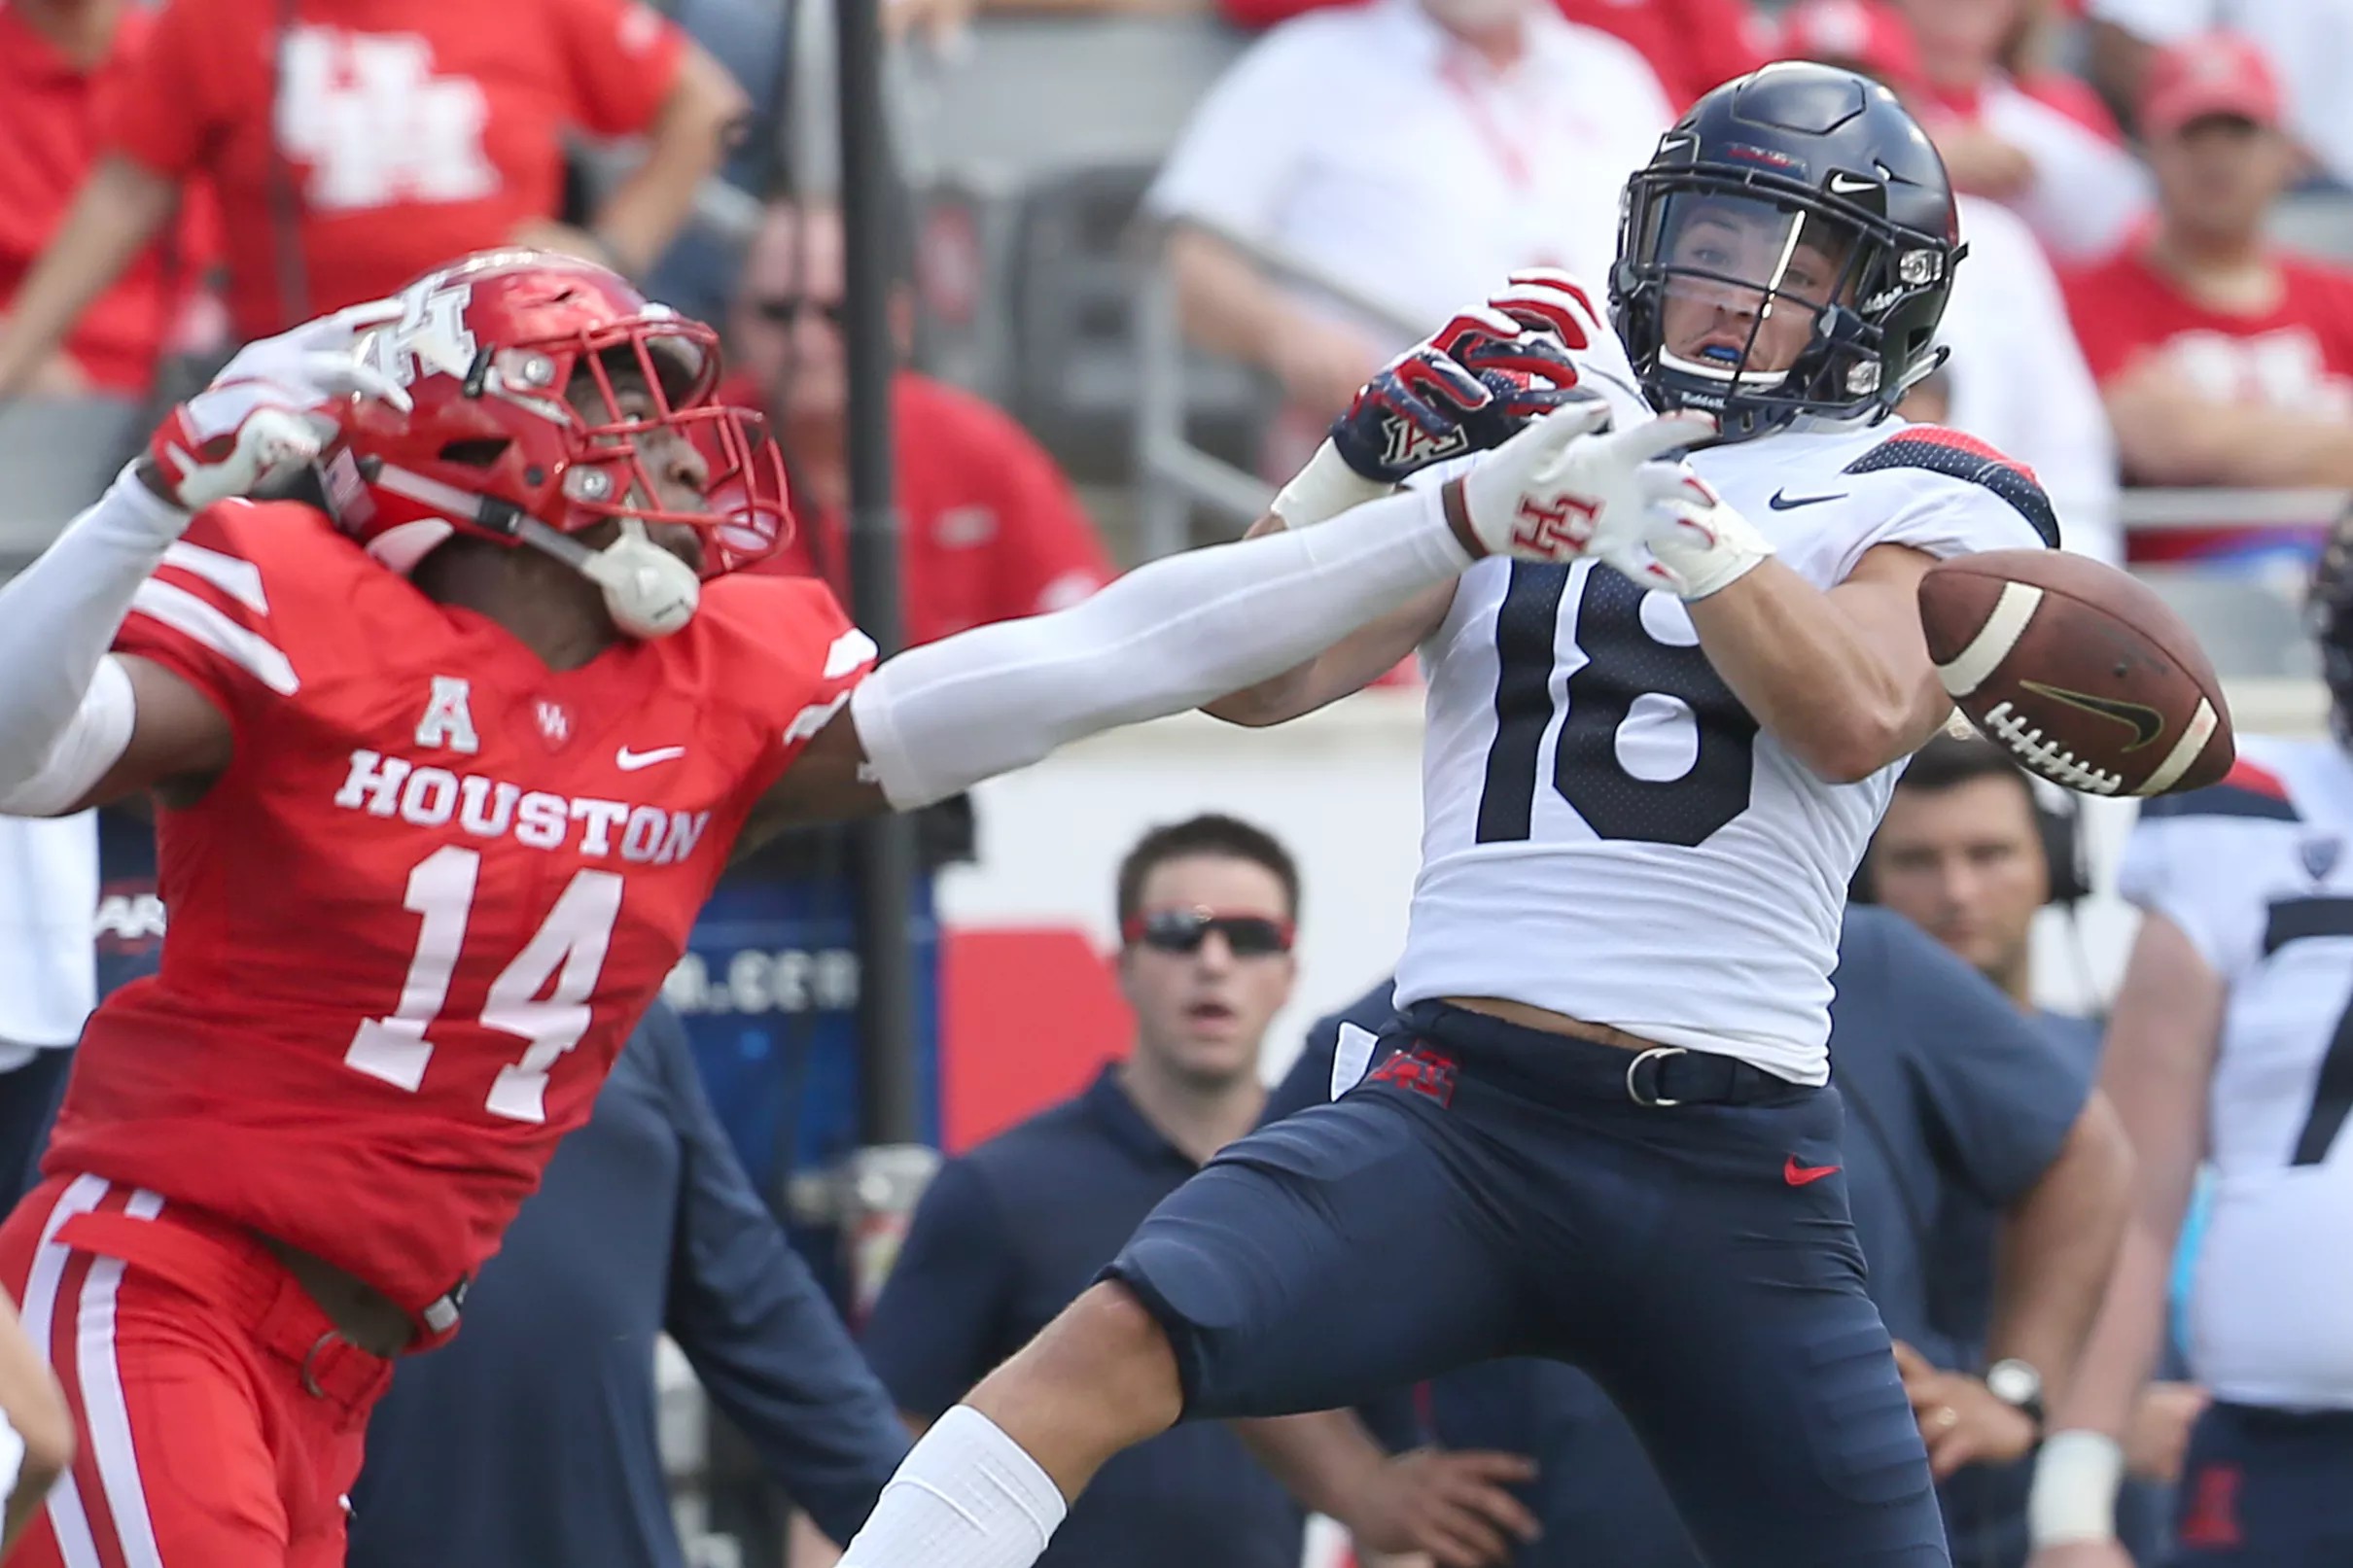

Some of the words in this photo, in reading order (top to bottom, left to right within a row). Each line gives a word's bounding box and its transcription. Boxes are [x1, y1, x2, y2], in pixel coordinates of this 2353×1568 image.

[1510, 492, 1604, 559] UH
[415, 676, 478, 754] A
[1475, 559, 1759, 848] 18
[334, 749, 711, 865] HOUSTON
[344, 844, 624, 1123] 14
